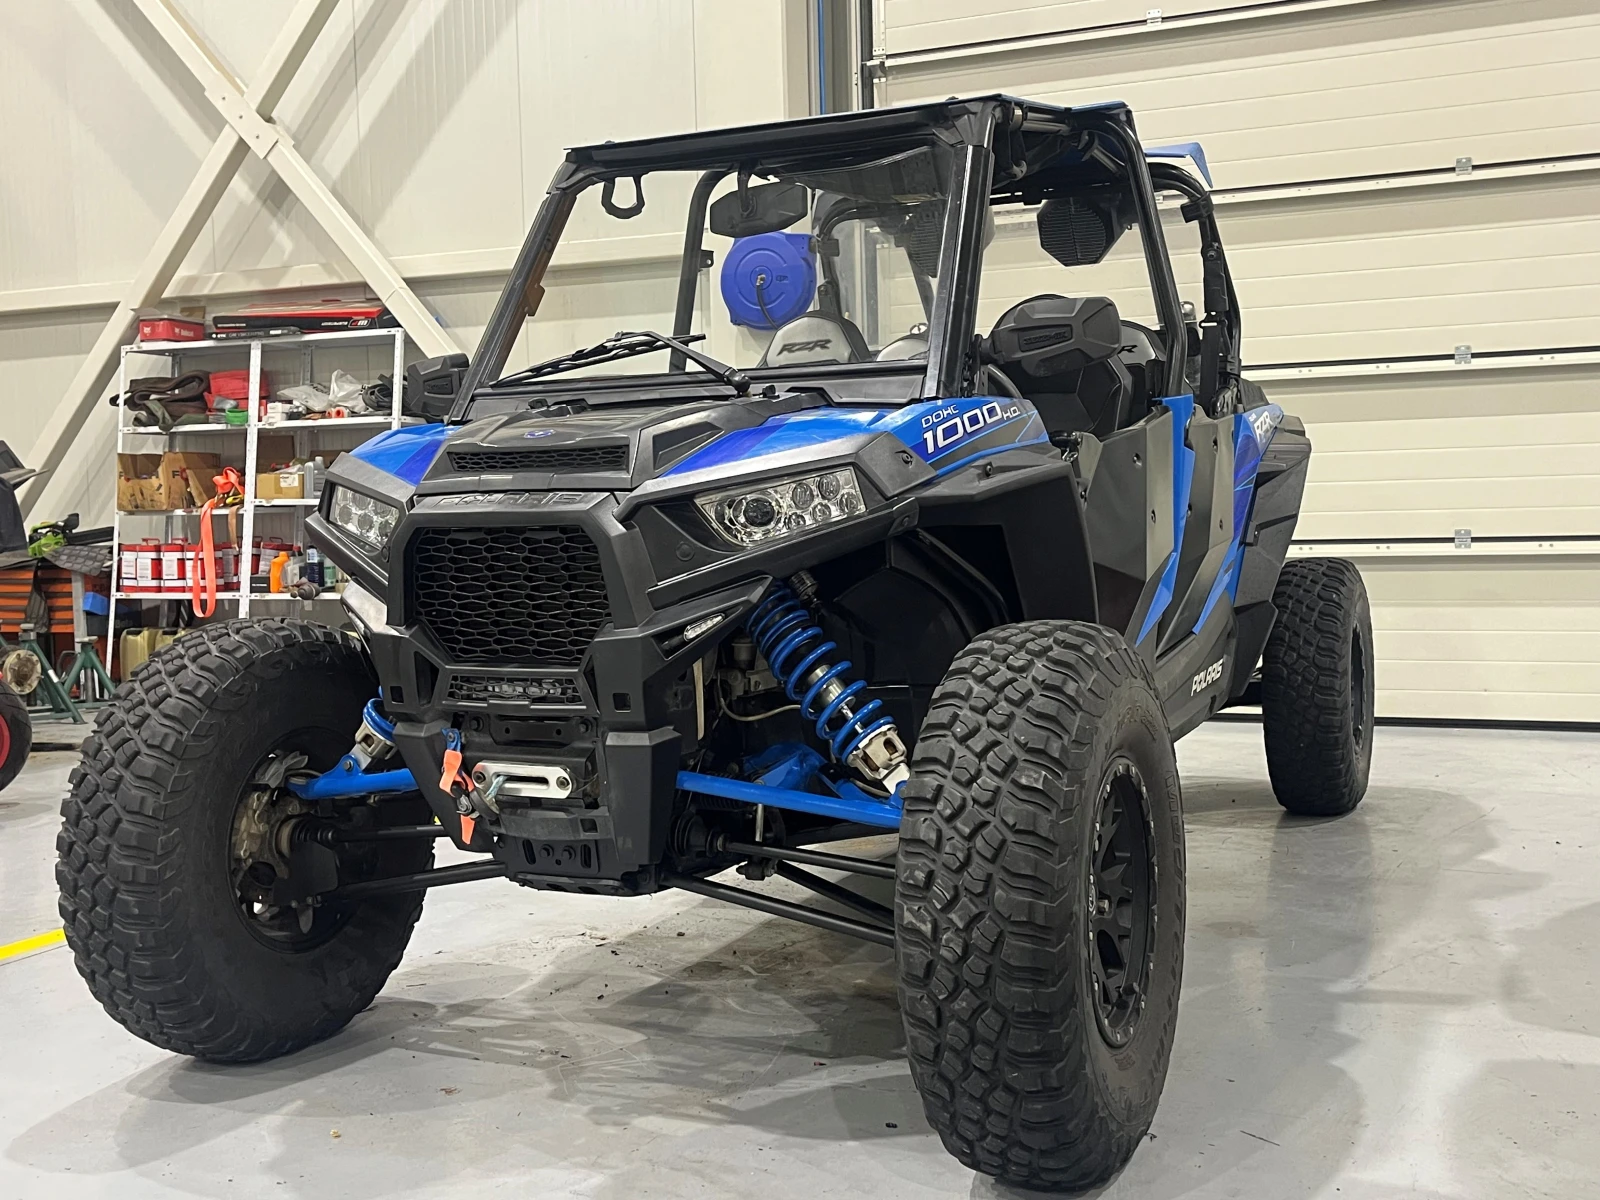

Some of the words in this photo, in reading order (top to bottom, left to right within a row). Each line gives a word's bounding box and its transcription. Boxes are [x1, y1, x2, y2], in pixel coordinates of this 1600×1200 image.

[776, 339, 832, 357] RZR
[921, 404, 960, 429] DOHC
[922, 401, 1002, 455] 1000
[1253, 410, 1275, 443] RZR
[1190, 657, 1224, 697] POLARIS
